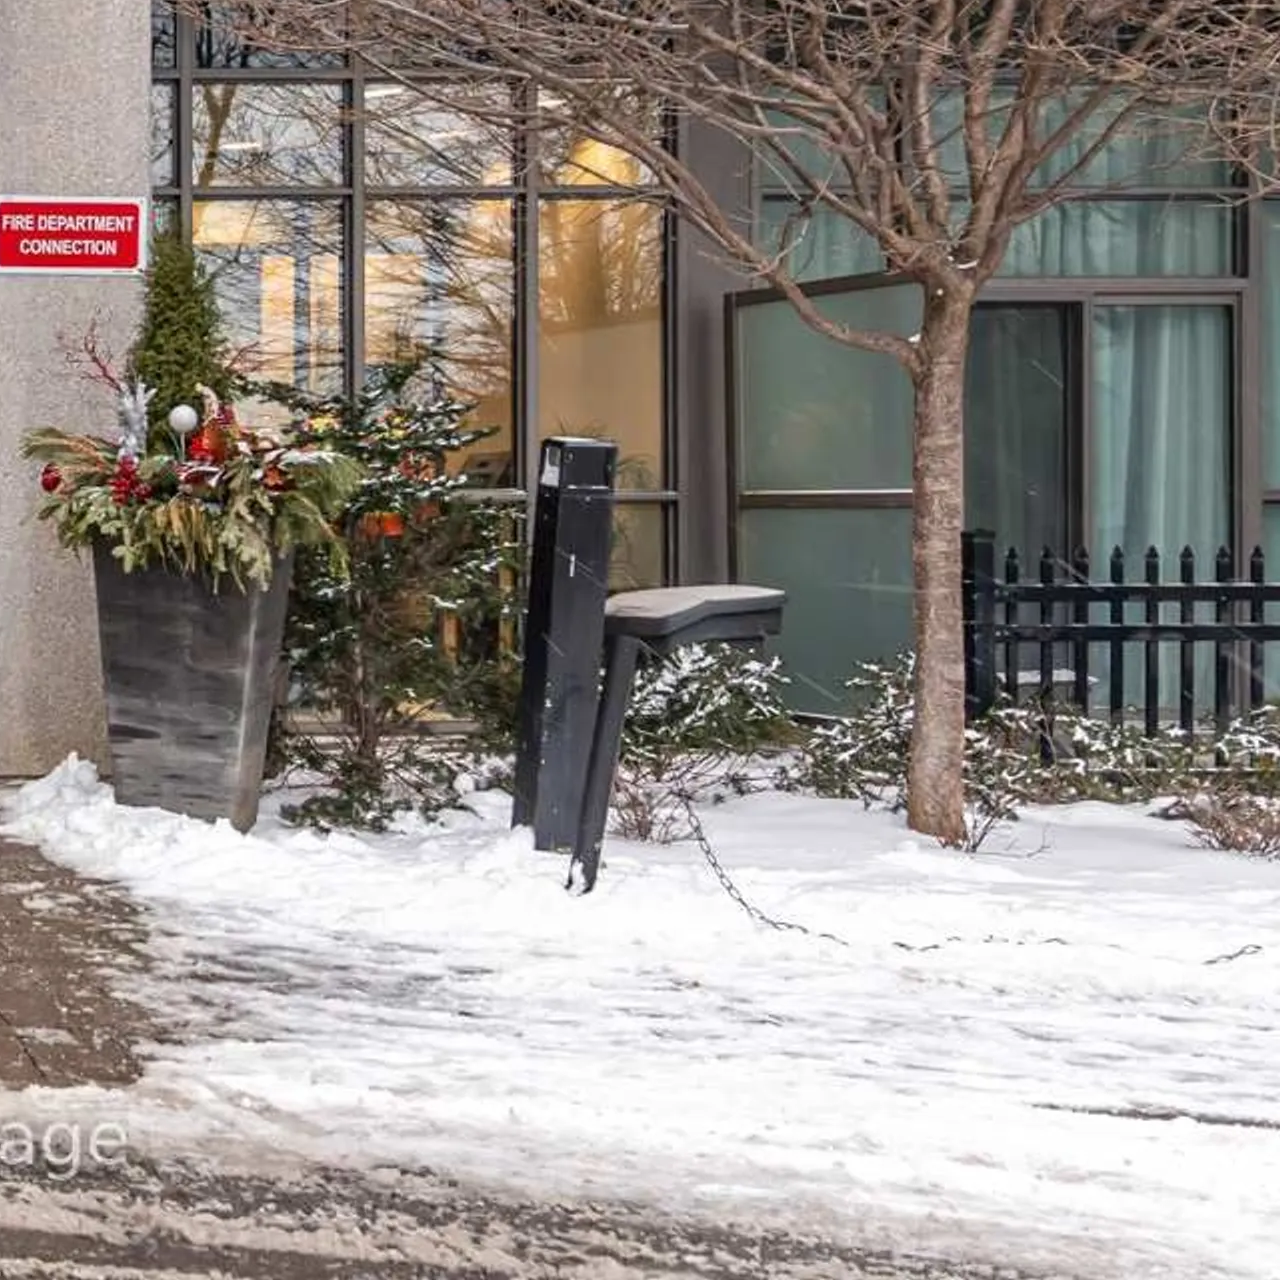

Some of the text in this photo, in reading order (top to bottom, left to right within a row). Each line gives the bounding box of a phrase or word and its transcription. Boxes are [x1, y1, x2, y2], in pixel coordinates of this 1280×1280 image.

[2, 214, 134, 232] FIRE DEPARTMENT
[19, 239, 117, 255] CONNECTION
